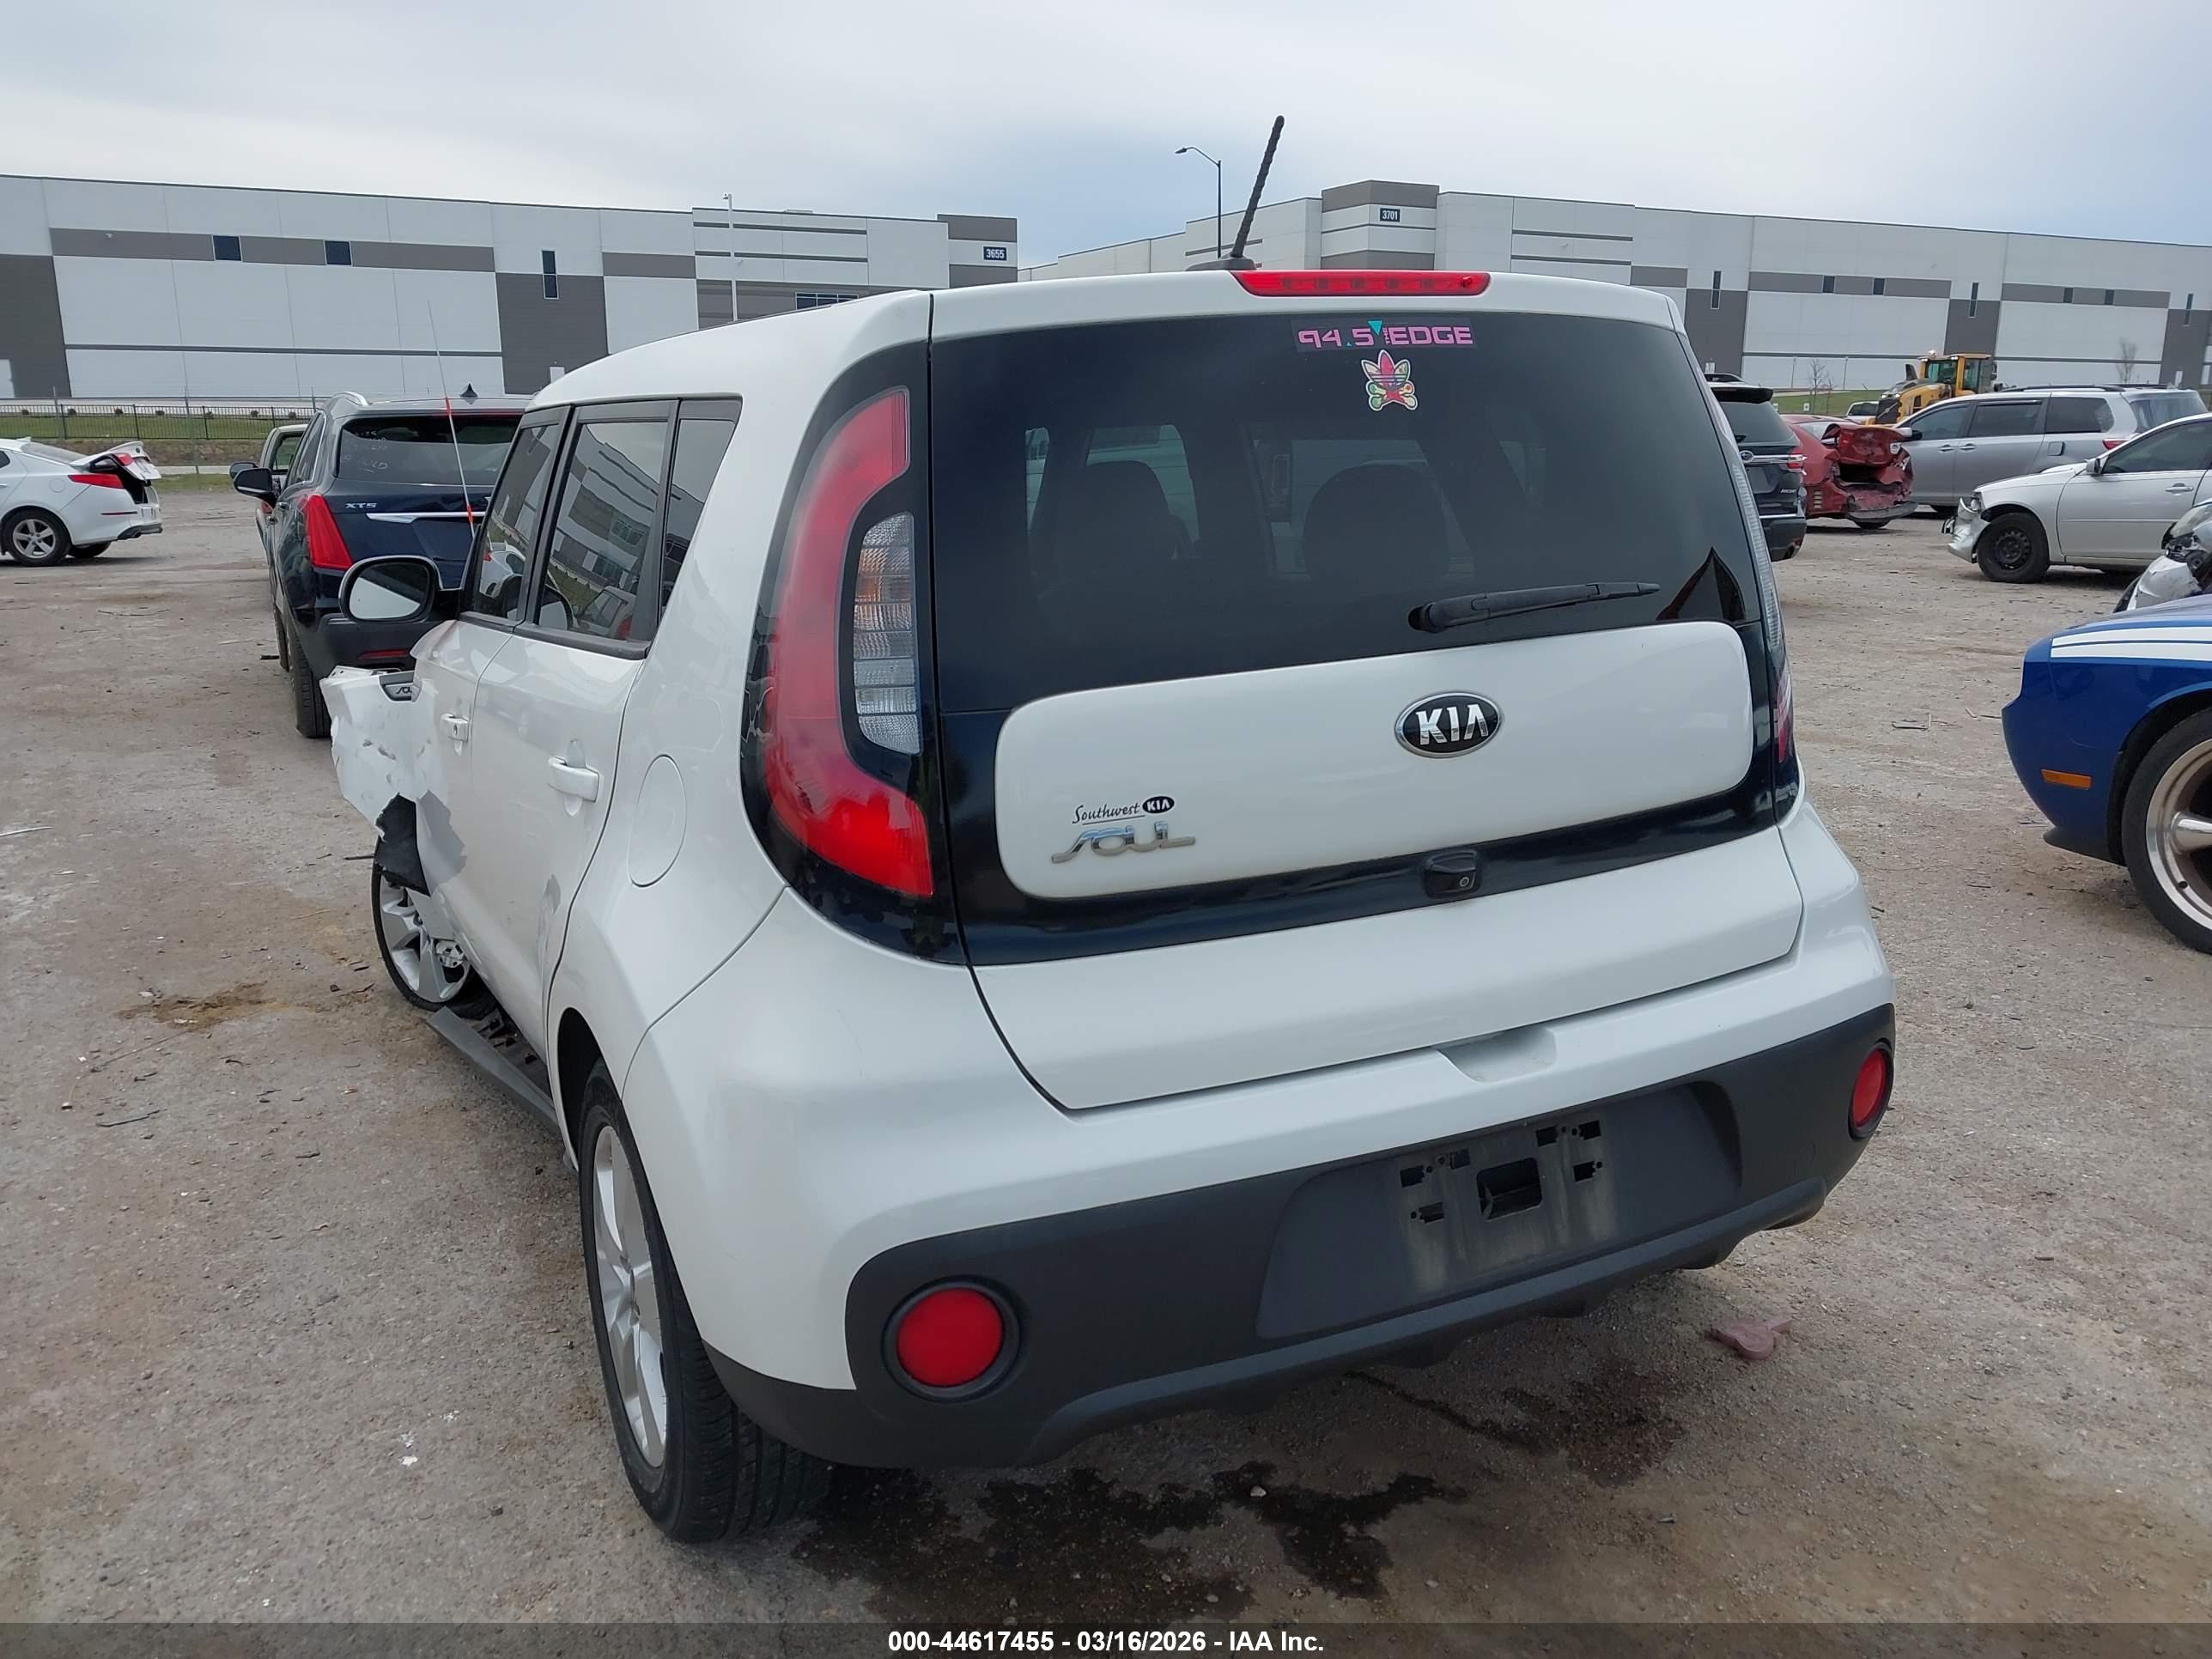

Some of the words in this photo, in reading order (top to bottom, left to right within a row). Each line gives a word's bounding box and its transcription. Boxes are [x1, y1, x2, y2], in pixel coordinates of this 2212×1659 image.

[1382, 210, 1398, 221] 3701
[986, 248, 1005, 259] 3655
[1389, 326, 1474, 344] EDGE
[1415, 703, 1489, 745] KIA
[1072, 803, 1141, 824] Southwest
[1146, 799, 1170, 811] KIA
